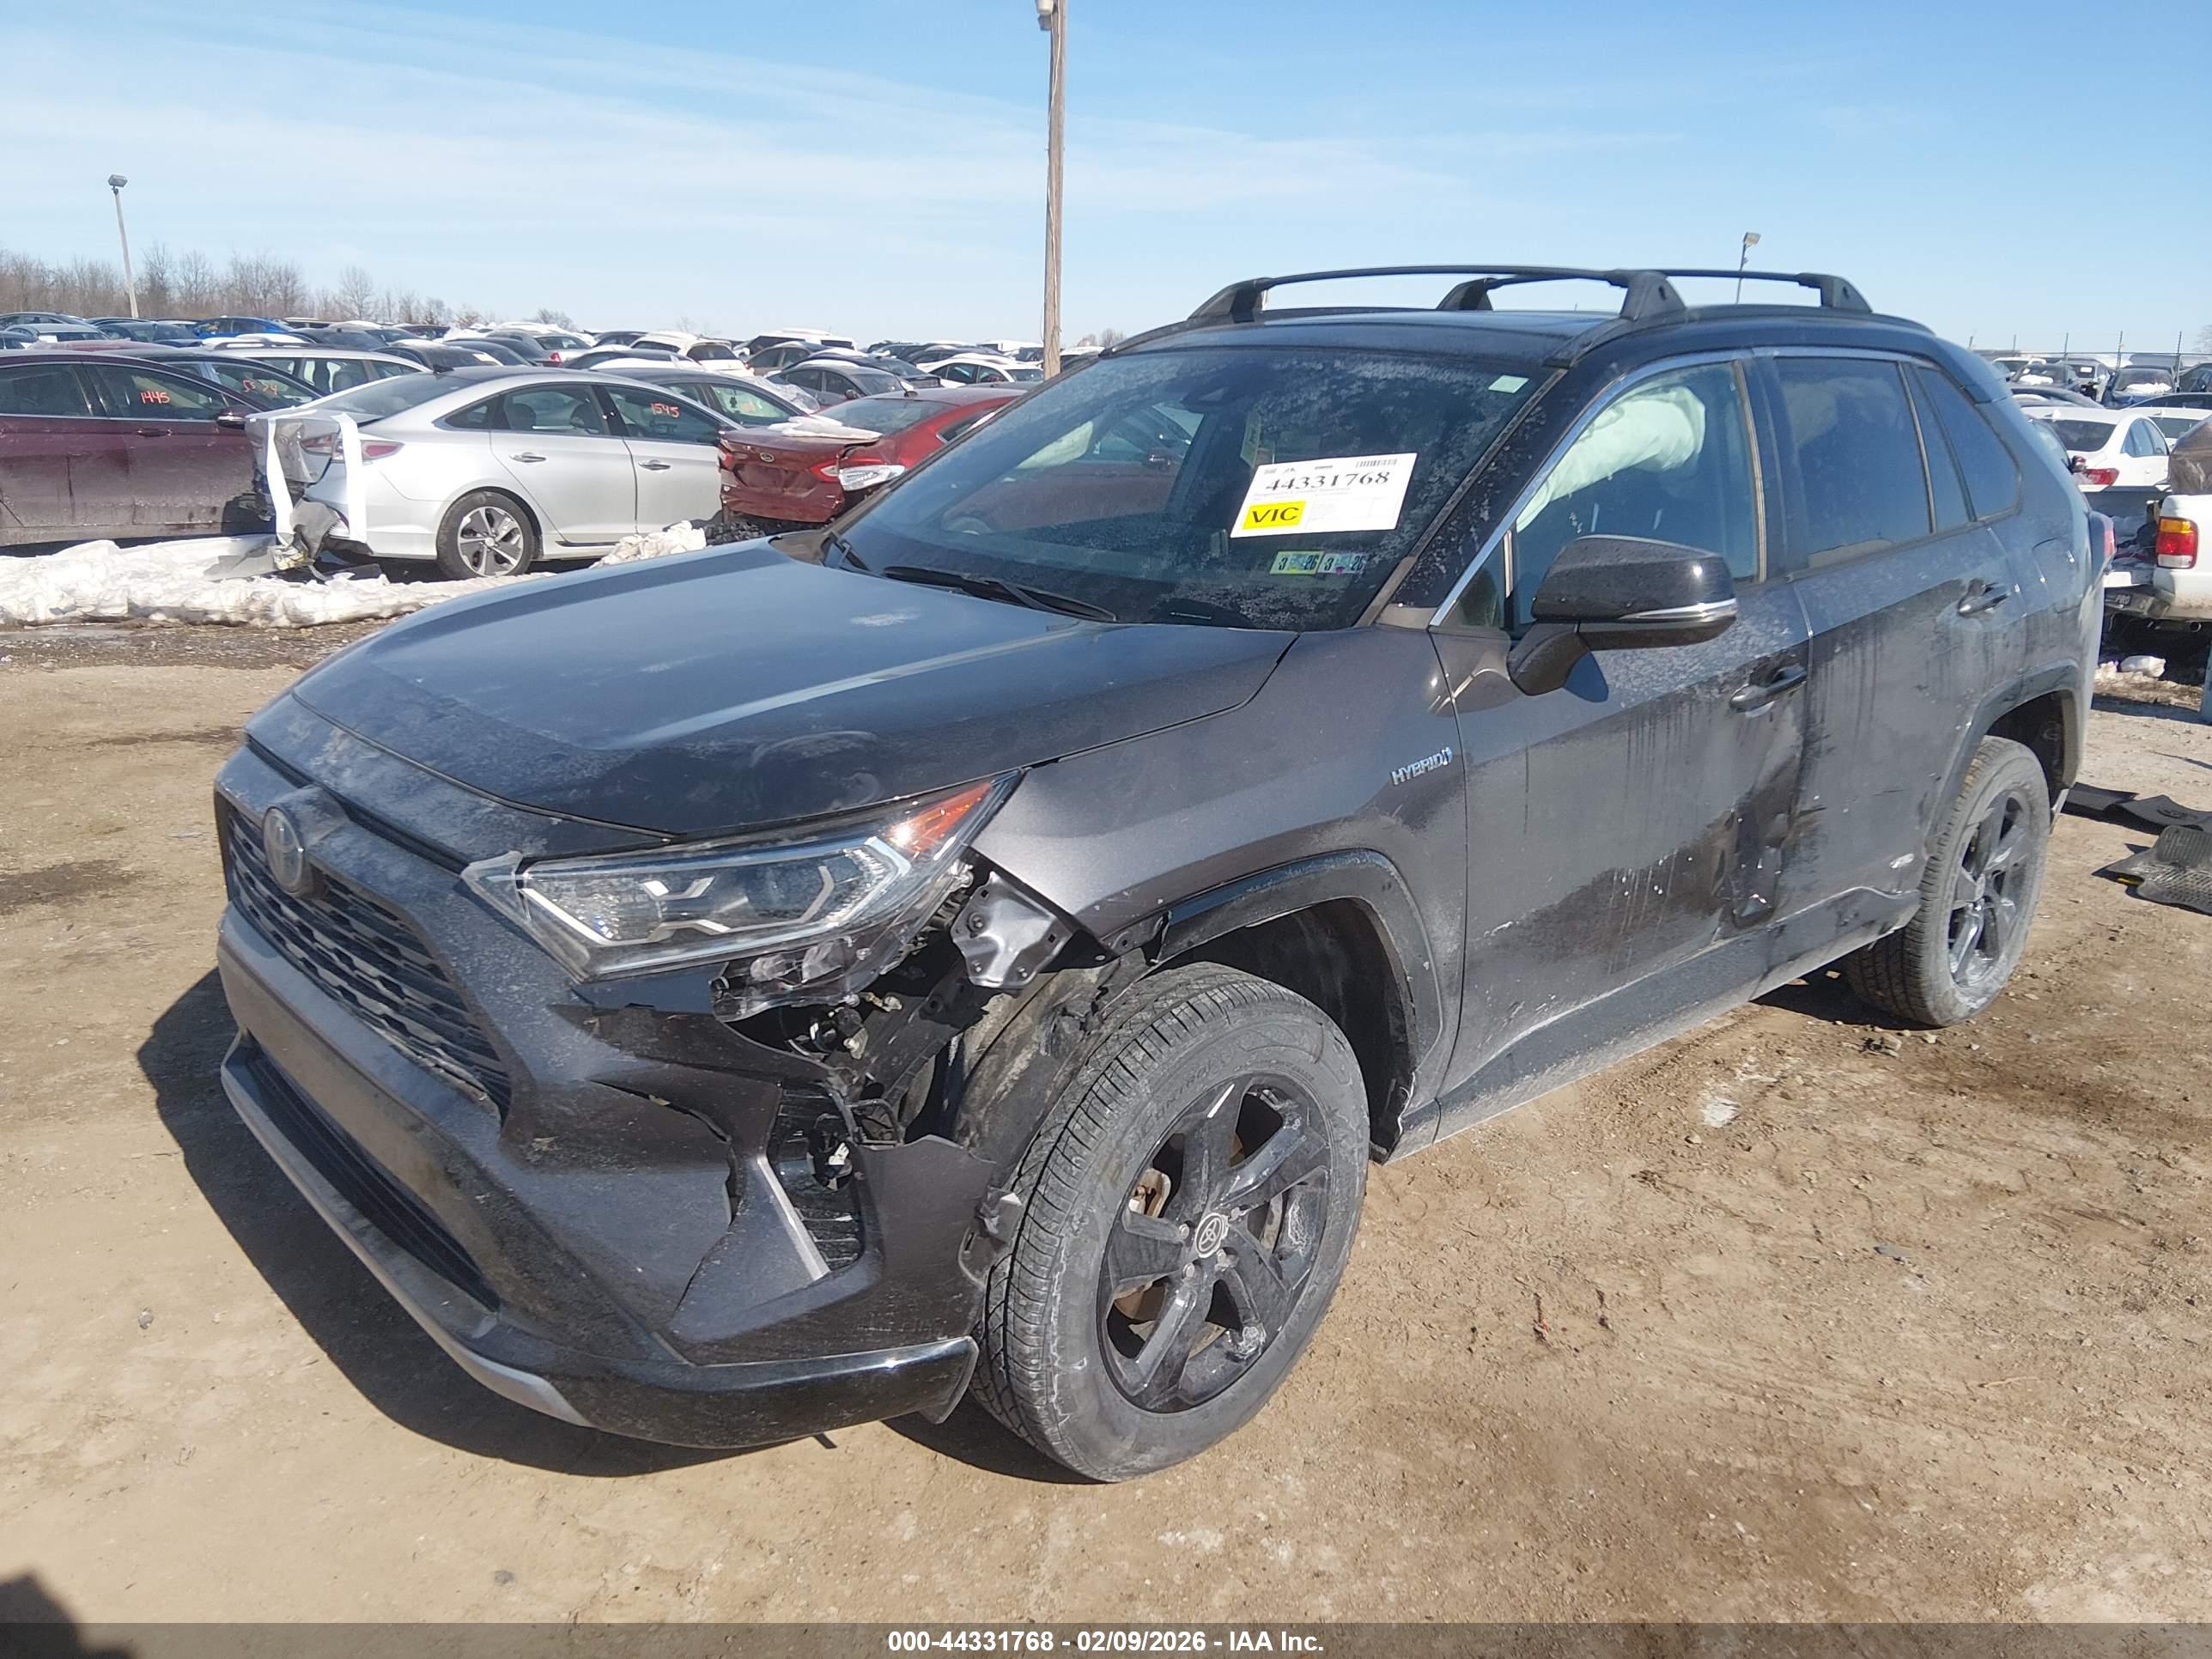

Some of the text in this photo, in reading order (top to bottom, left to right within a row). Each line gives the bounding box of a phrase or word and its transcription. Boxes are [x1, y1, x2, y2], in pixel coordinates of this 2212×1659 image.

[140, 391, 170, 404] 1445
[651, 403, 680, 418] 1545
[1266, 471, 1390, 491] 44331768
[1251, 507, 1300, 524] VIC
[1278, 556, 1288, 570] 3
[1323, 557, 1334, 571] 3
[1390, 752, 1444, 786] HYBRID
